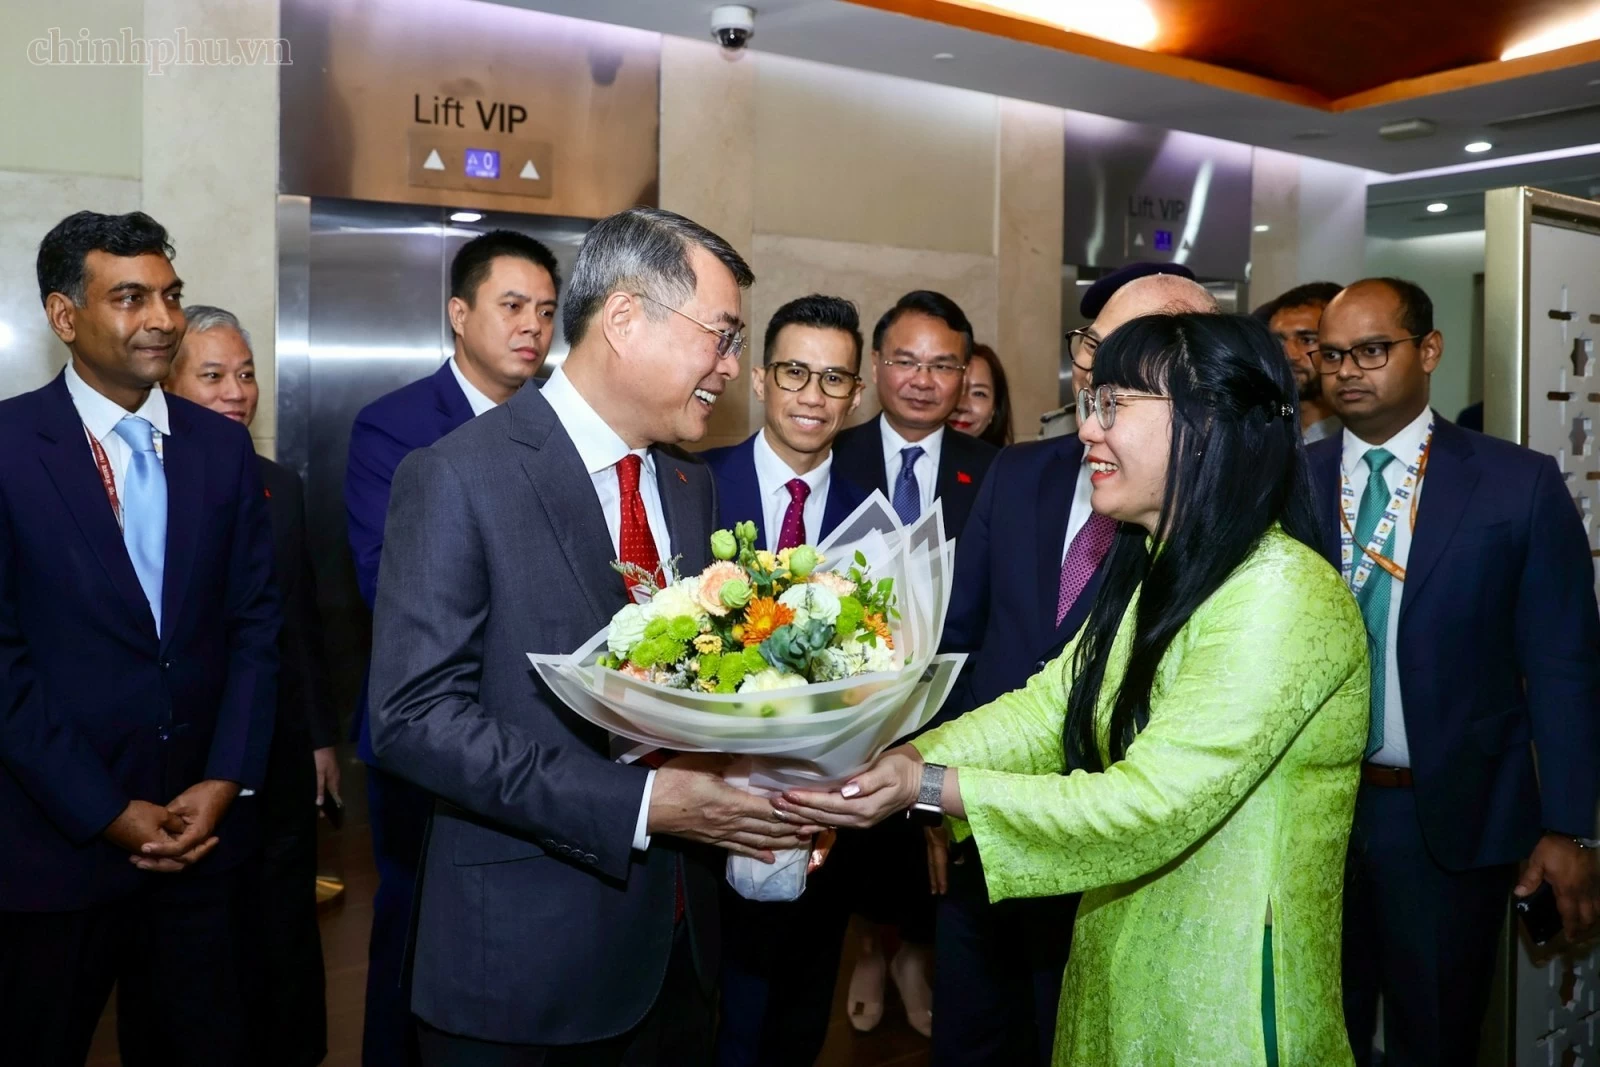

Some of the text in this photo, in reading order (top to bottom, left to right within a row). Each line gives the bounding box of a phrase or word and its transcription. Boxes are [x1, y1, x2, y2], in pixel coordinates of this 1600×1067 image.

[415, 93, 528, 133] Lift VIP
[1128, 195, 1186, 222] Lift VIP
